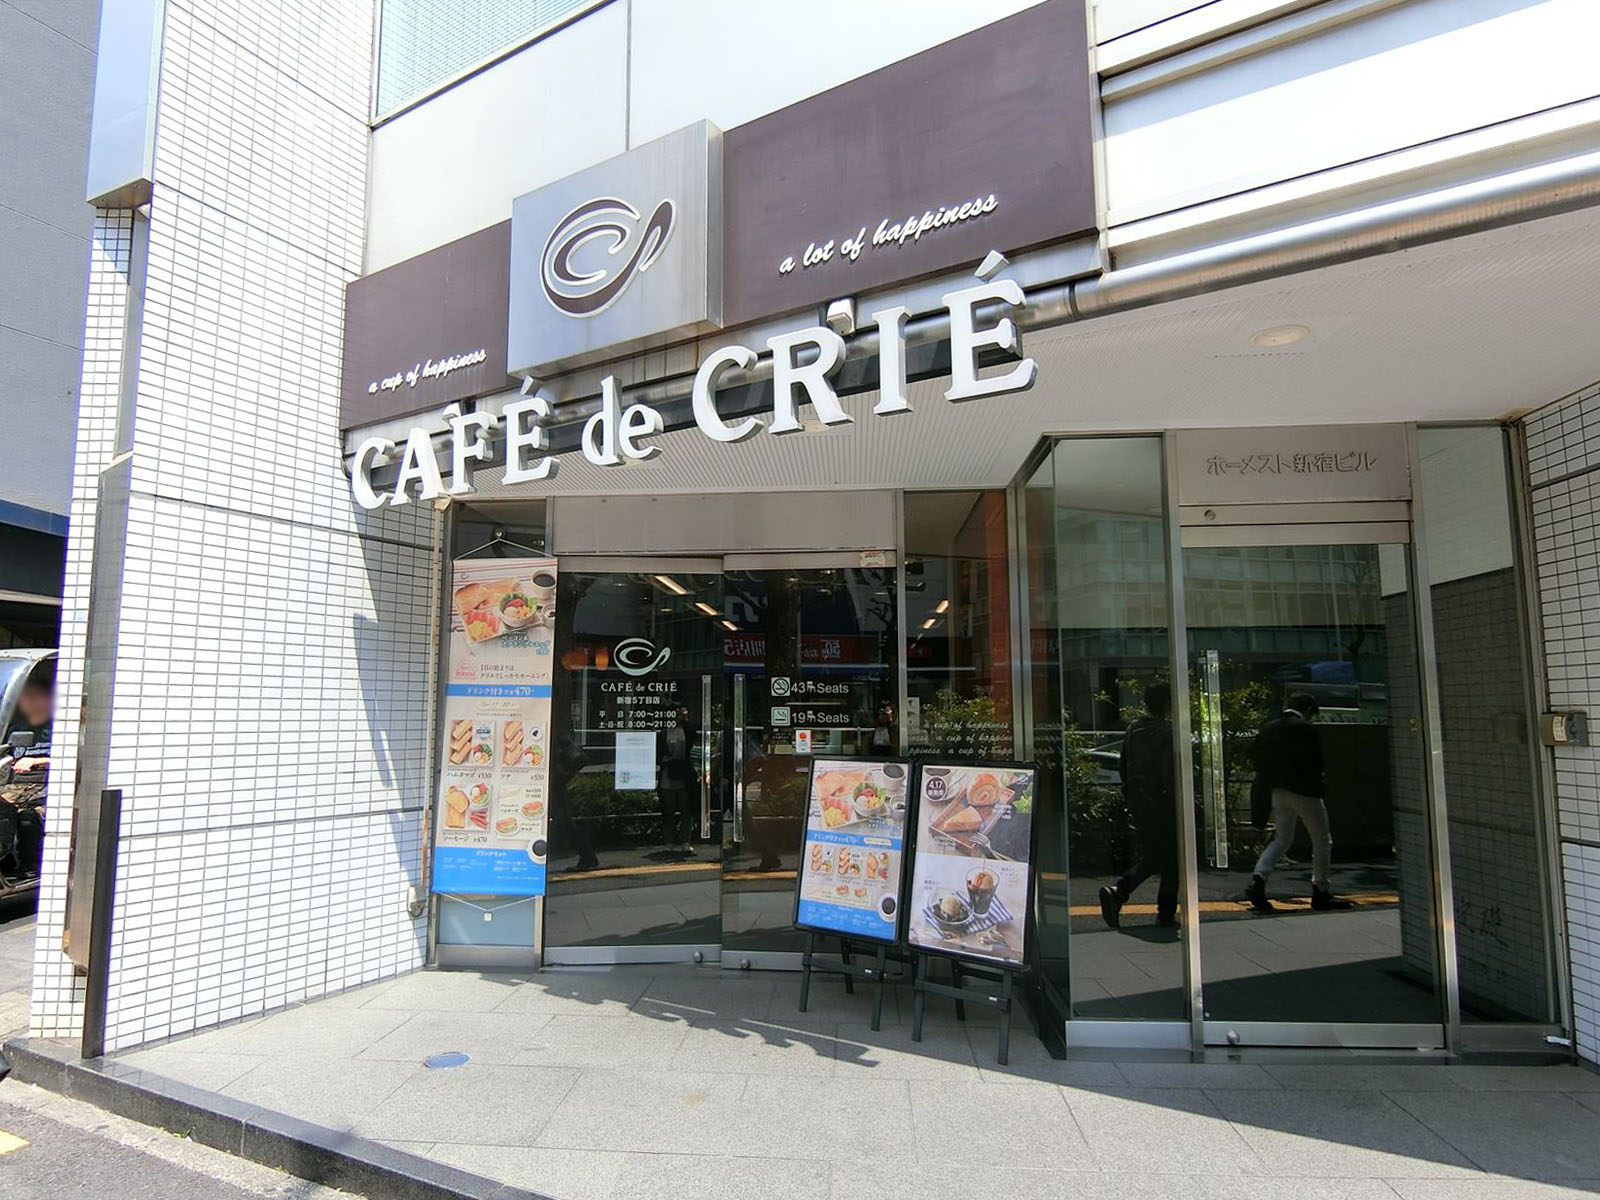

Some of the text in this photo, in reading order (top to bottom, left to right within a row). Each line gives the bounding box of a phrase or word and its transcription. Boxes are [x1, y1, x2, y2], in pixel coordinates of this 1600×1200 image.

[779, 194, 998, 274] a lot of happiness
[352, 249, 1038, 510] CAFÉ de CRIÉ
[368, 348, 487, 394] a cup of happiness
[1206, 452, 1378, 475] ホーメスト新宿ビル
[600, 681, 678, 692] CAFÉ de CRIÉ
[791, 682, 850, 694] 43 Seats
[616, 696, 661, 705] 新宿5丁目店
[791, 712, 850, 724] 19 Seats
